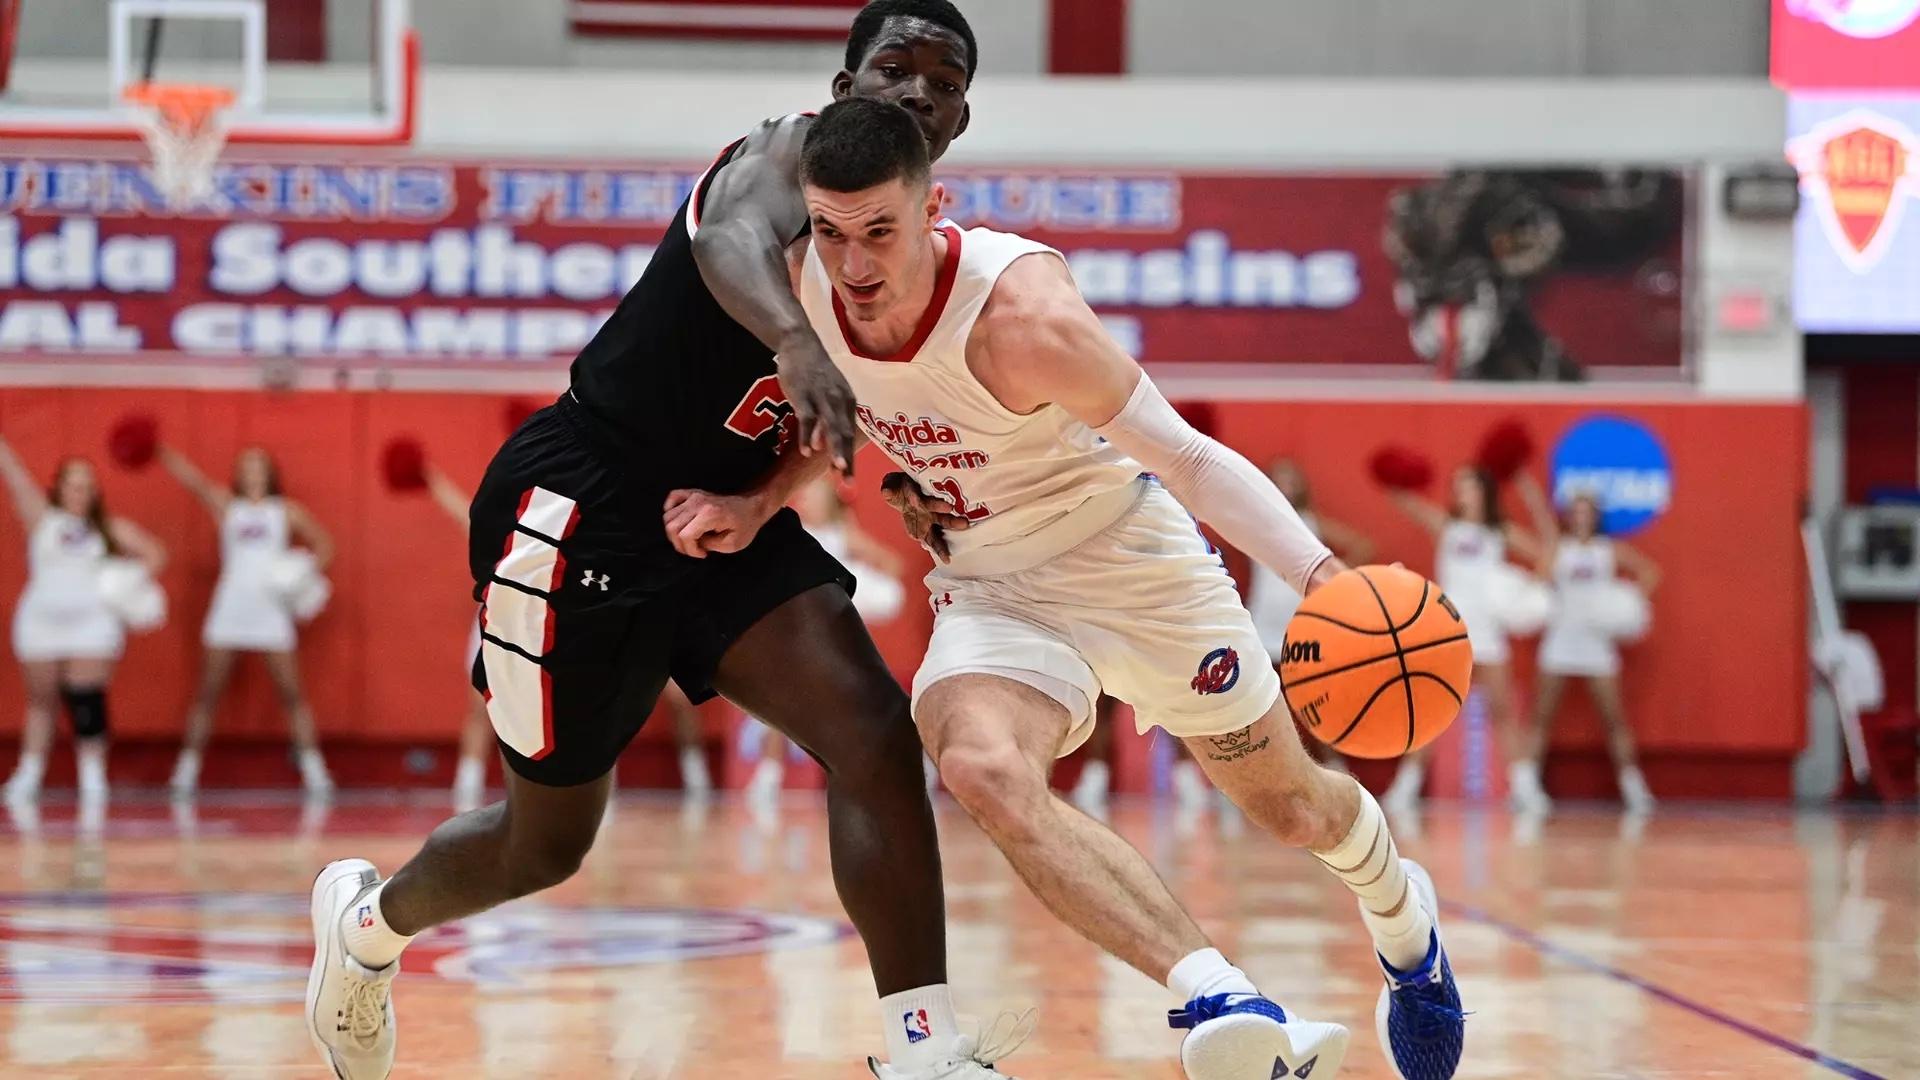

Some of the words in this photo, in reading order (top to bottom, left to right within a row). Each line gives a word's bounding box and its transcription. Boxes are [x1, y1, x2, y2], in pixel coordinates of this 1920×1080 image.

[208, 220, 660, 301] Souther
[1070, 228, 1362, 309] asins
[1281, 631, 1322, 664] lson
